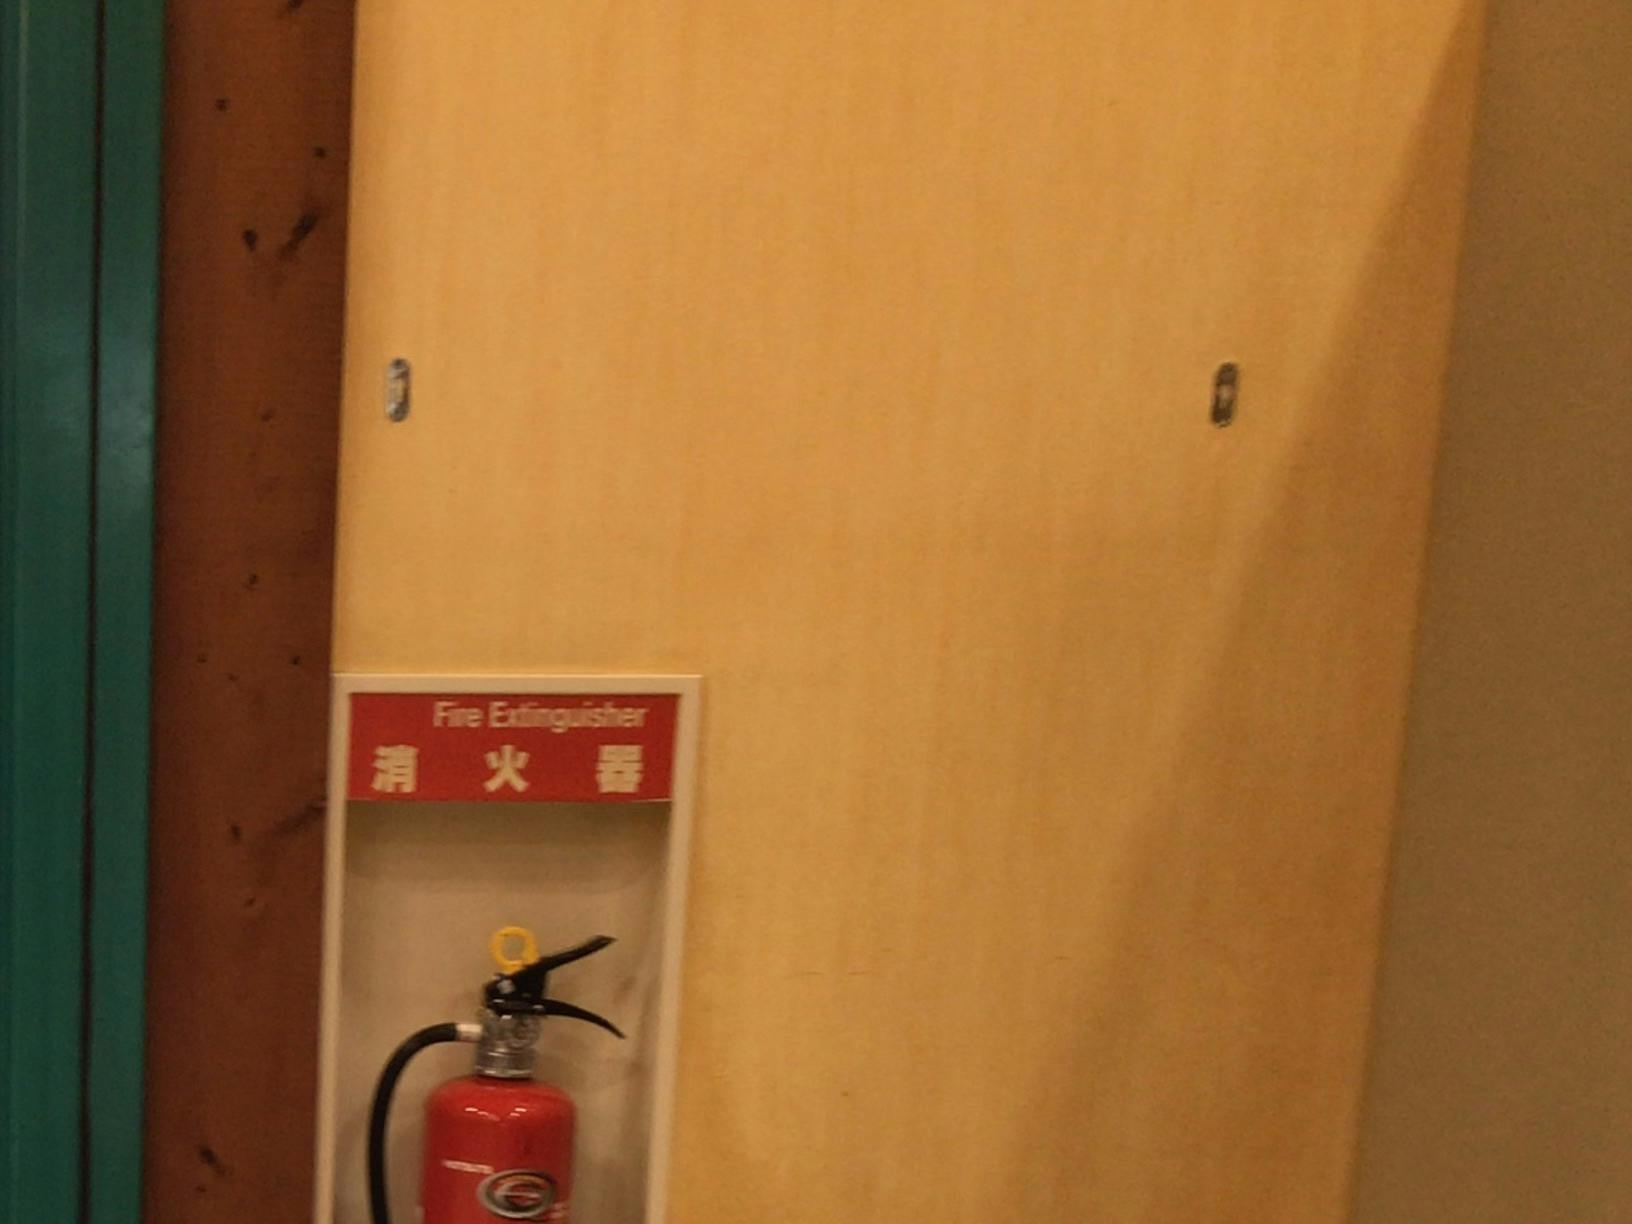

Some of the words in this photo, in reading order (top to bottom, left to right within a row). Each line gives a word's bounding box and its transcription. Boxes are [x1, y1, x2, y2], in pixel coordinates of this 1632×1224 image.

[433, 701, 483, 728] Fire
[489, 701, 649, 733] Extinguisher
[371, 744, 645, 794] 消火器
